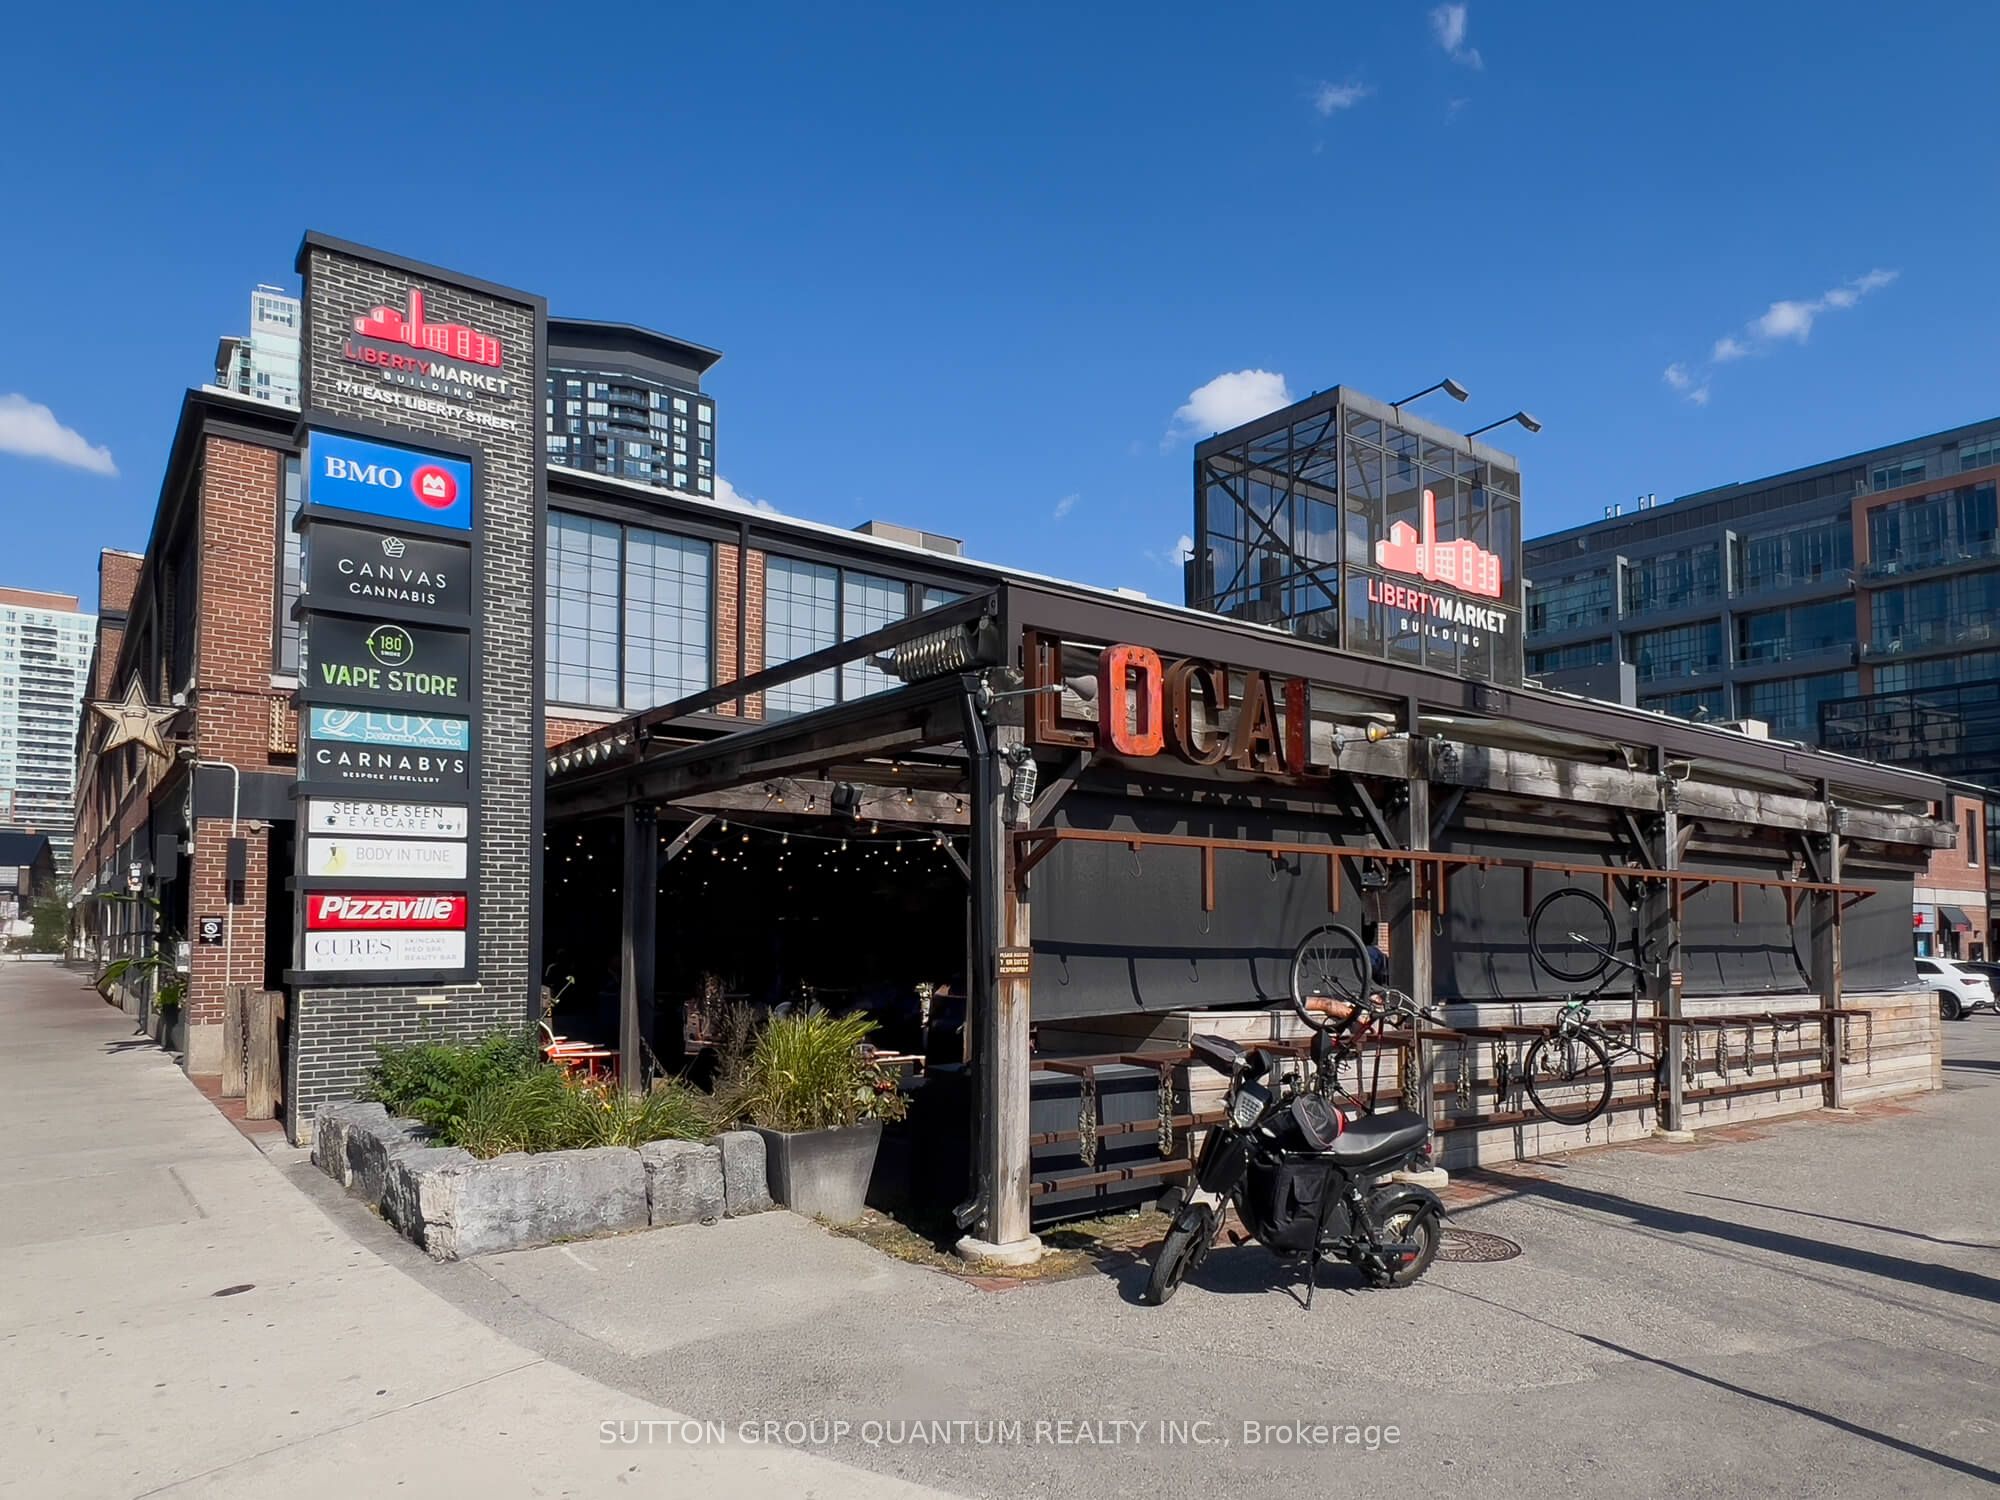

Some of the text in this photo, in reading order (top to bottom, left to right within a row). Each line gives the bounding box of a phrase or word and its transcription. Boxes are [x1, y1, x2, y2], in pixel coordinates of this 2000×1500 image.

[344, 341, 509, 394] LIBERTYMARKET
[383, 371, 476, 399] BUILDING
[336, 381, 517, 431] 171 EAST LIBERTY STREET
[325, 456, 403, 489] BMO
[338, 558, 447, 589] CANVAS
[349, 582, 436, 605] CANNABIS
[1368, 578, 1507, 634] LIBERTYMARKET
[1401, 618, 1480, 648] BUILDING
[321, 663, 458, 697] VAPE STORE
[1023, 629, 1330, 776] LOCAL
[316, 749, 464, 773] CARNABYS
[342, 771, 440, 783] BESPOKE JEWELLERY
[333, 802, 444, 818] SEE & BE SEEN
[349, 815, 427, 830] EYECARE
[356, 847, 450, 862] BODY IN TUNE
[318, 895, 454, 920] Pizzaville
[314, 938, 392, 956] CURES
